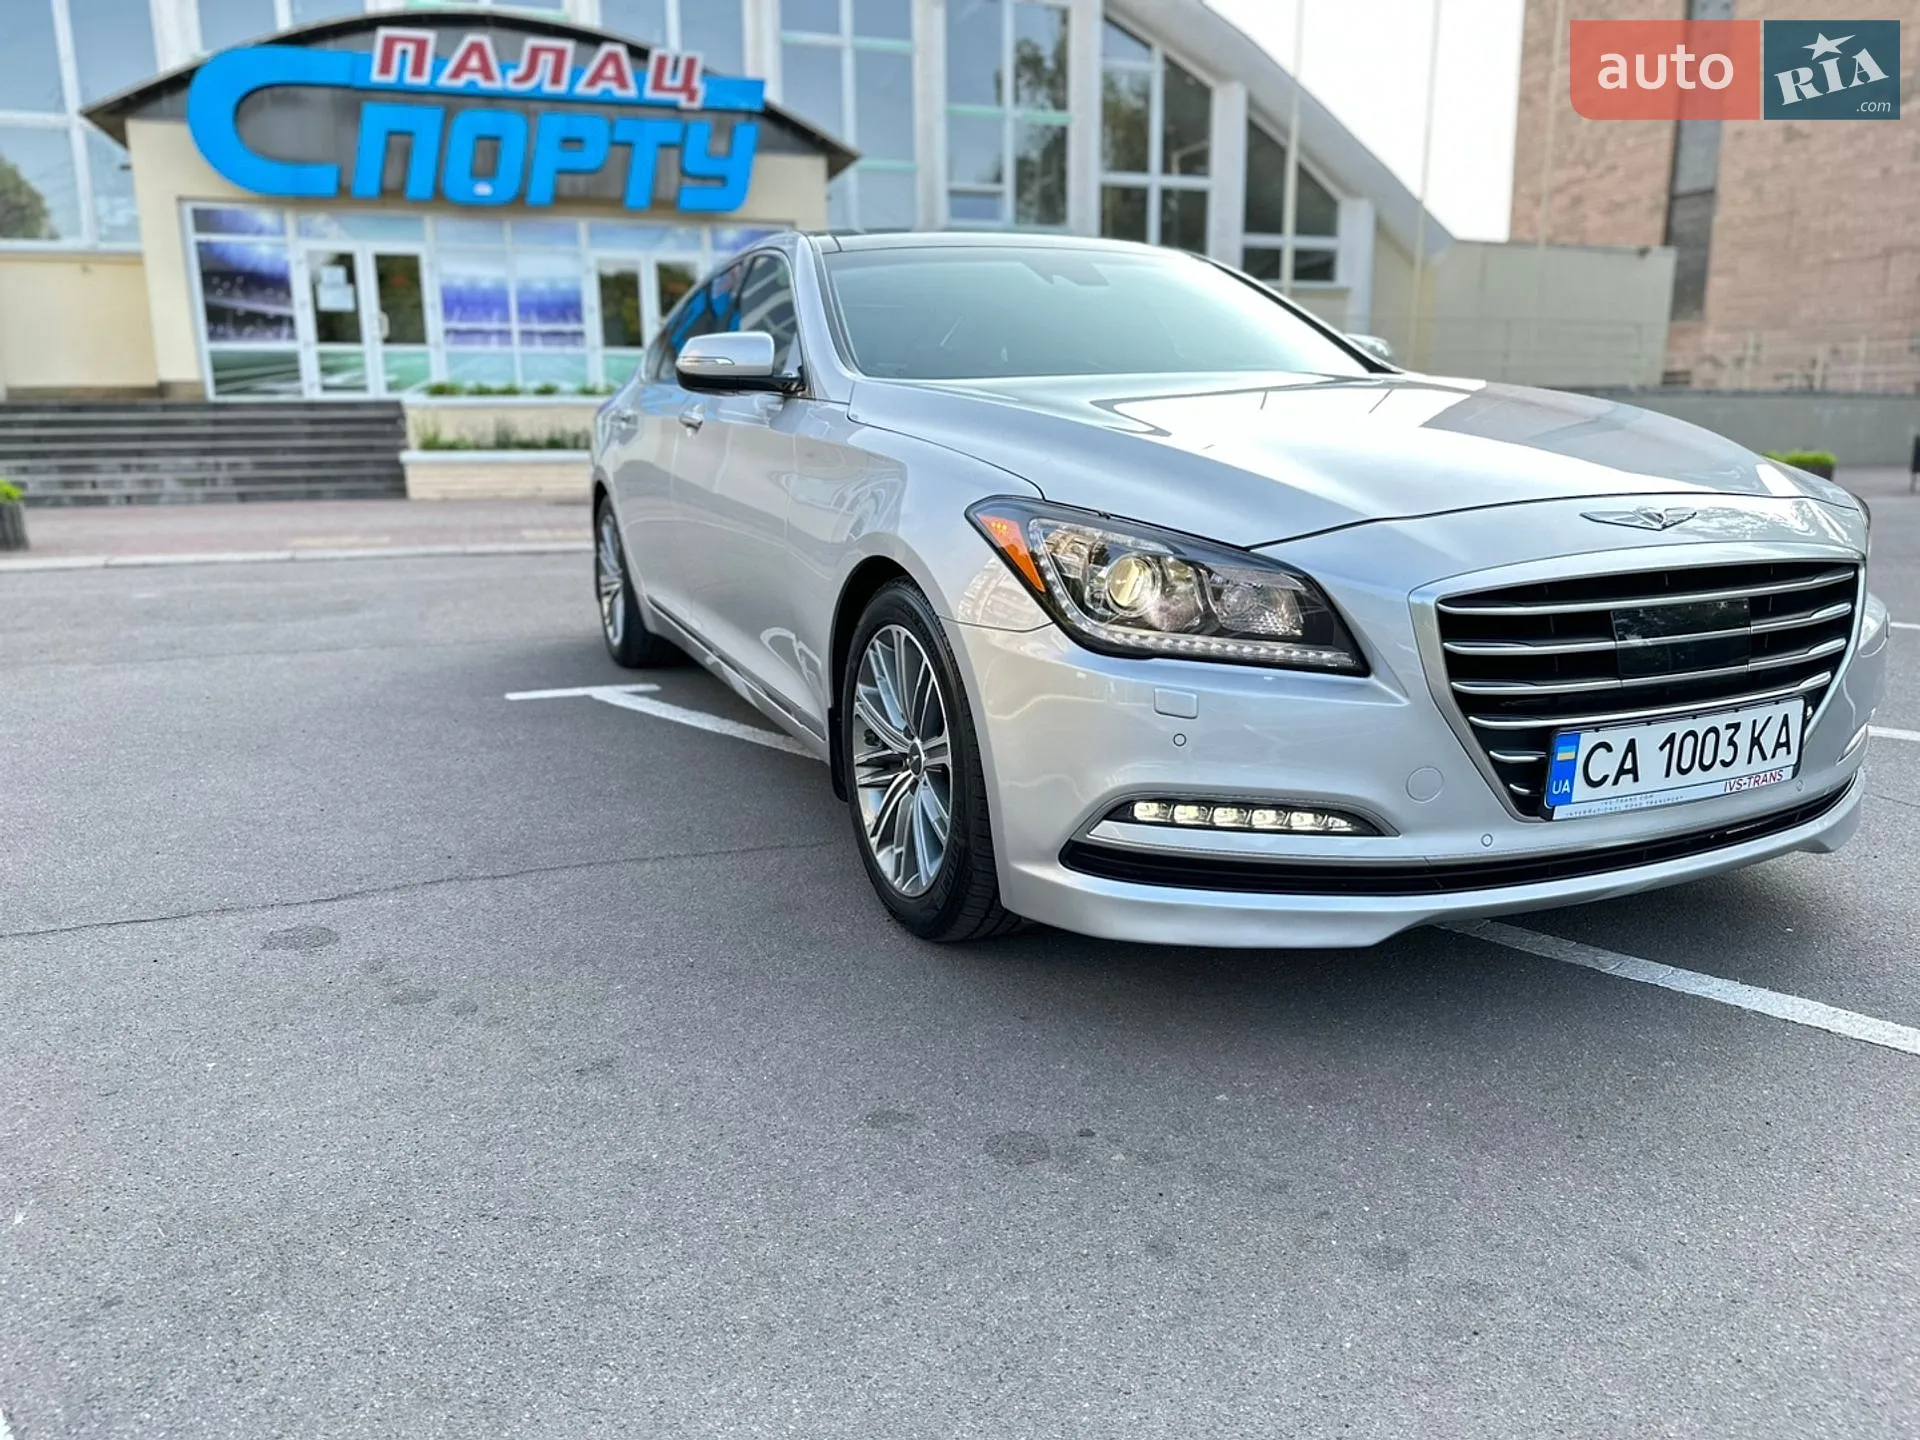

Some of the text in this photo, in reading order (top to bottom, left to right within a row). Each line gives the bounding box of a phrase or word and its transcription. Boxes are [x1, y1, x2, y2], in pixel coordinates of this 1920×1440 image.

[372, 28, 704, 108] ПАЛАЦ
[187, 44, 765, 213] СПОРТУ
[1552, 779, 1571, 795] UA
[1582, 713, 1792, 788] CA 1003 KA
[1723, 769, 1784, 793] IVS-TRANS
